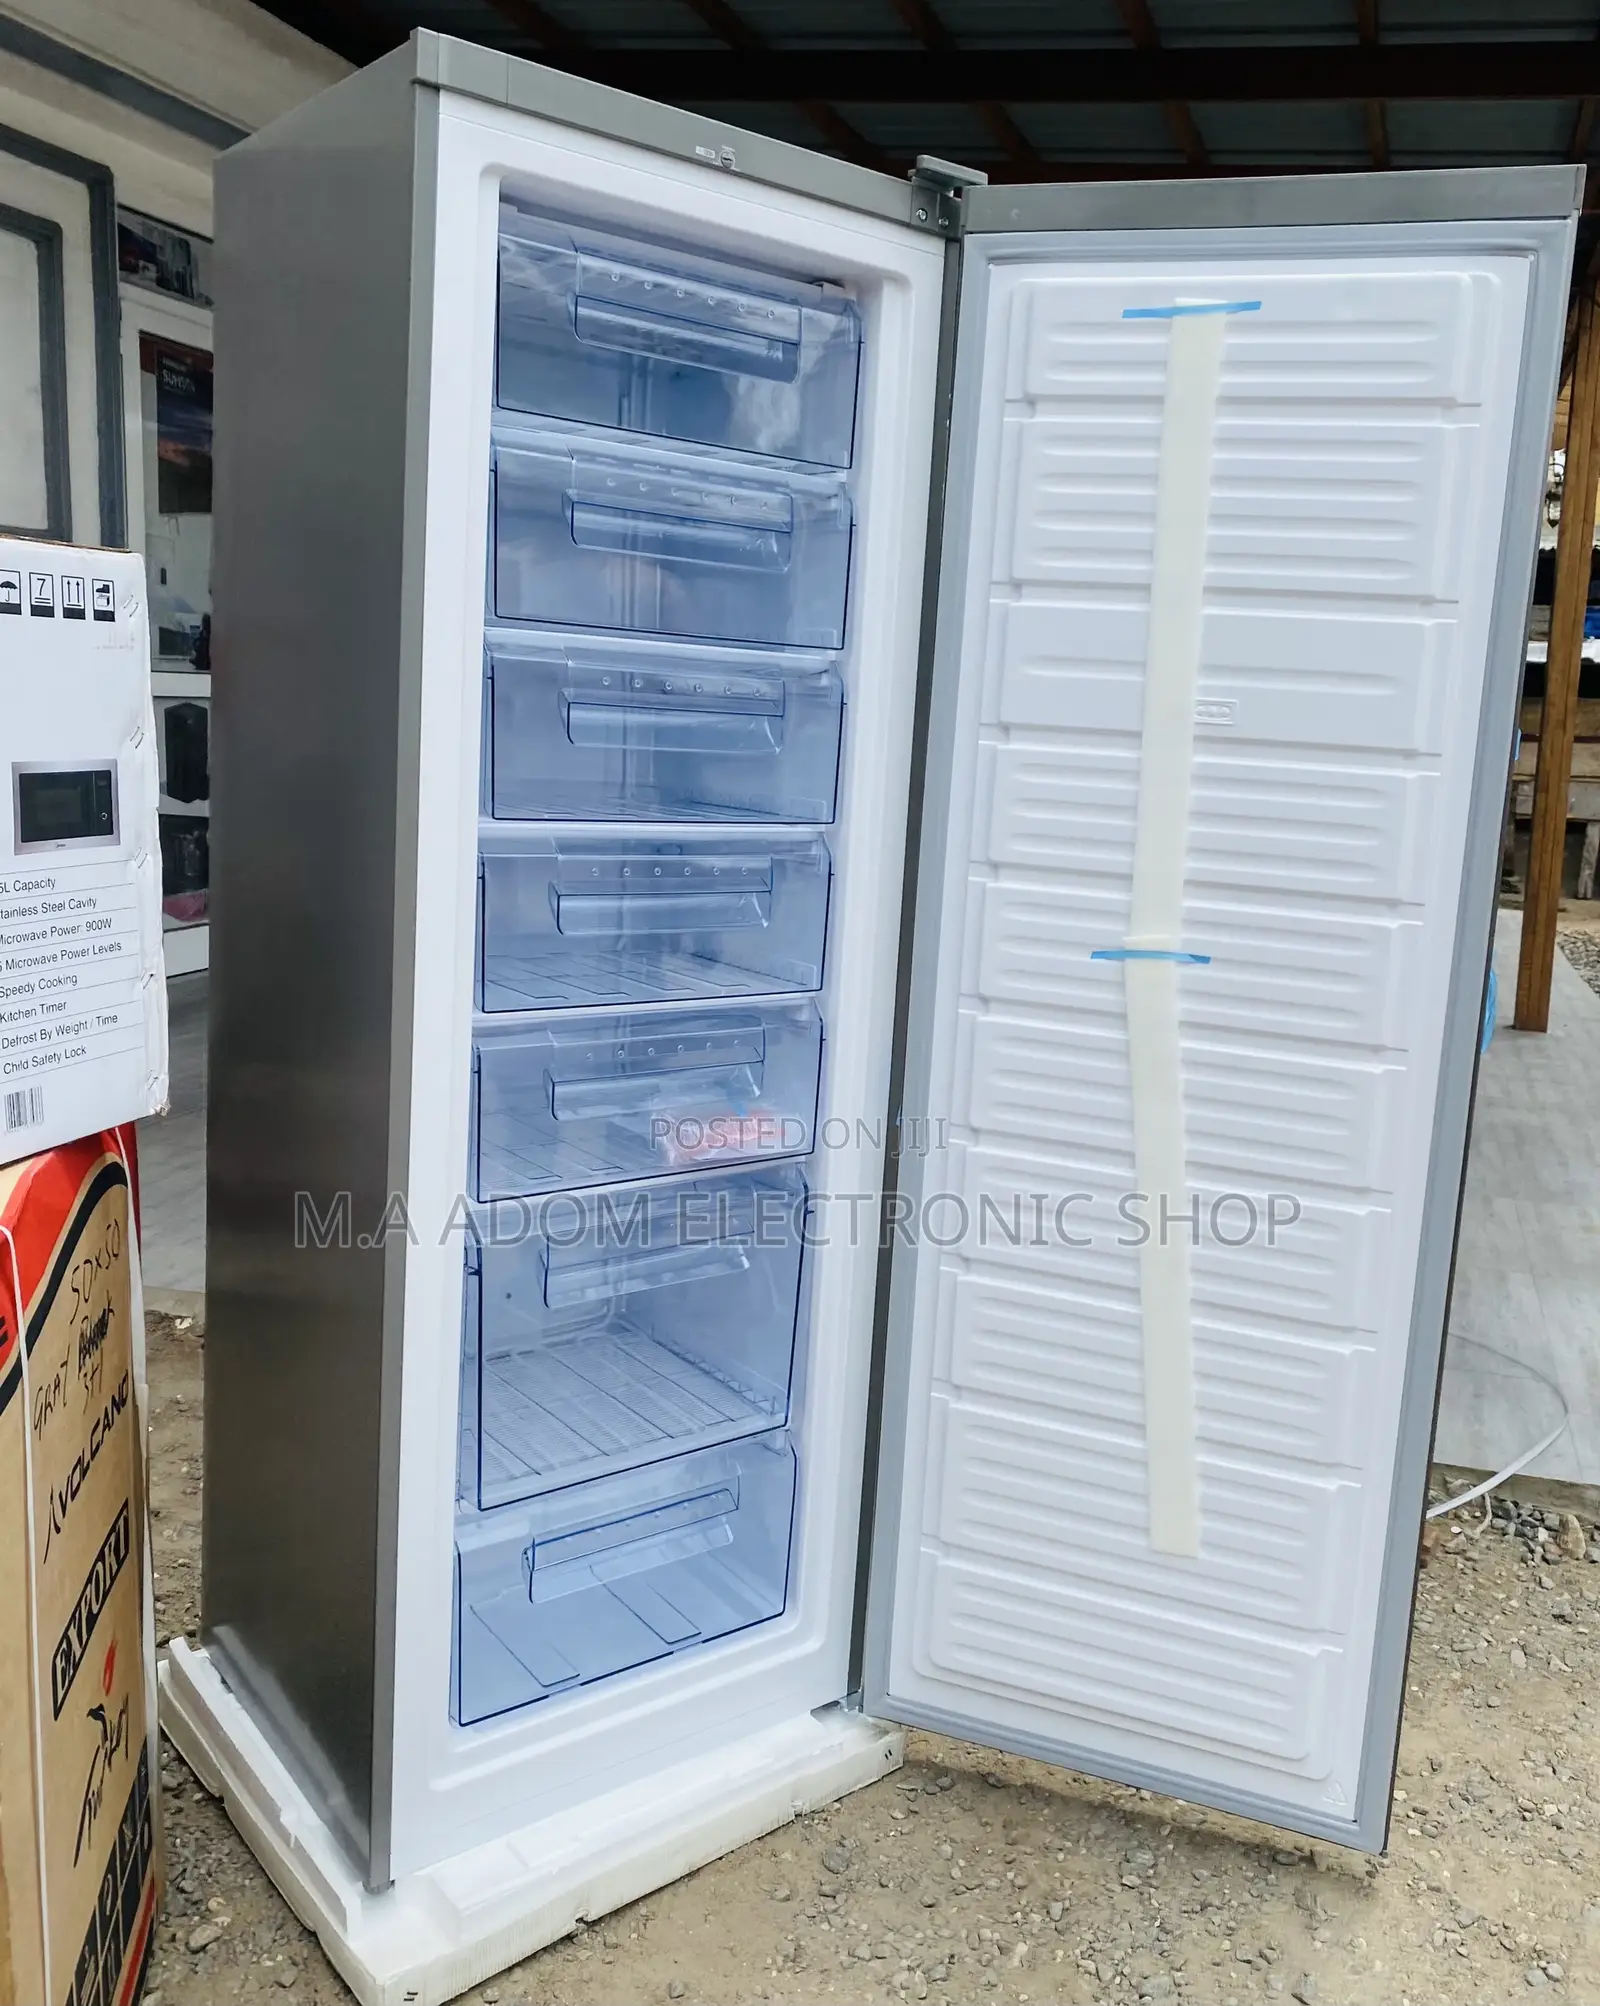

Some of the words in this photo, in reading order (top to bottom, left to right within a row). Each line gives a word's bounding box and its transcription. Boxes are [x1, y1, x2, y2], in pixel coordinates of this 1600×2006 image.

[37, 578, 46, 596] 7
[13, 878, 56, 893] Capacity
[41, 900, 66, 914] Steel
[68, 897, 97, 910] Cavity
[85, 918, 112, 931] 900W
[5, 953, 58, 970] Microwave
[60, 947, 90, 960] Power
[92, 941, 122, 955] Levels
[0, 982, 35, 999] Speedy
[38, 974, 78, 990] Cooking
[0, 1008, 37, 1023] Kitchen
[39, 1001, 67, 1015] Timer
[2, 1032, 37, 1050] Defrost
[40, 1028, 53, 1041] By
[55, 1020, 88, 1035] Weight
[95, 1014, 118, 1026] Time
[3, 1058, 29, 1075] Child
[31, 1052, 61, 1068] Safety
[64, 1045, 87, 1059] Lock
[58, 1372, 129, 1520] VOLCANO
[56, 1508, 128, 1708] EXPORT
